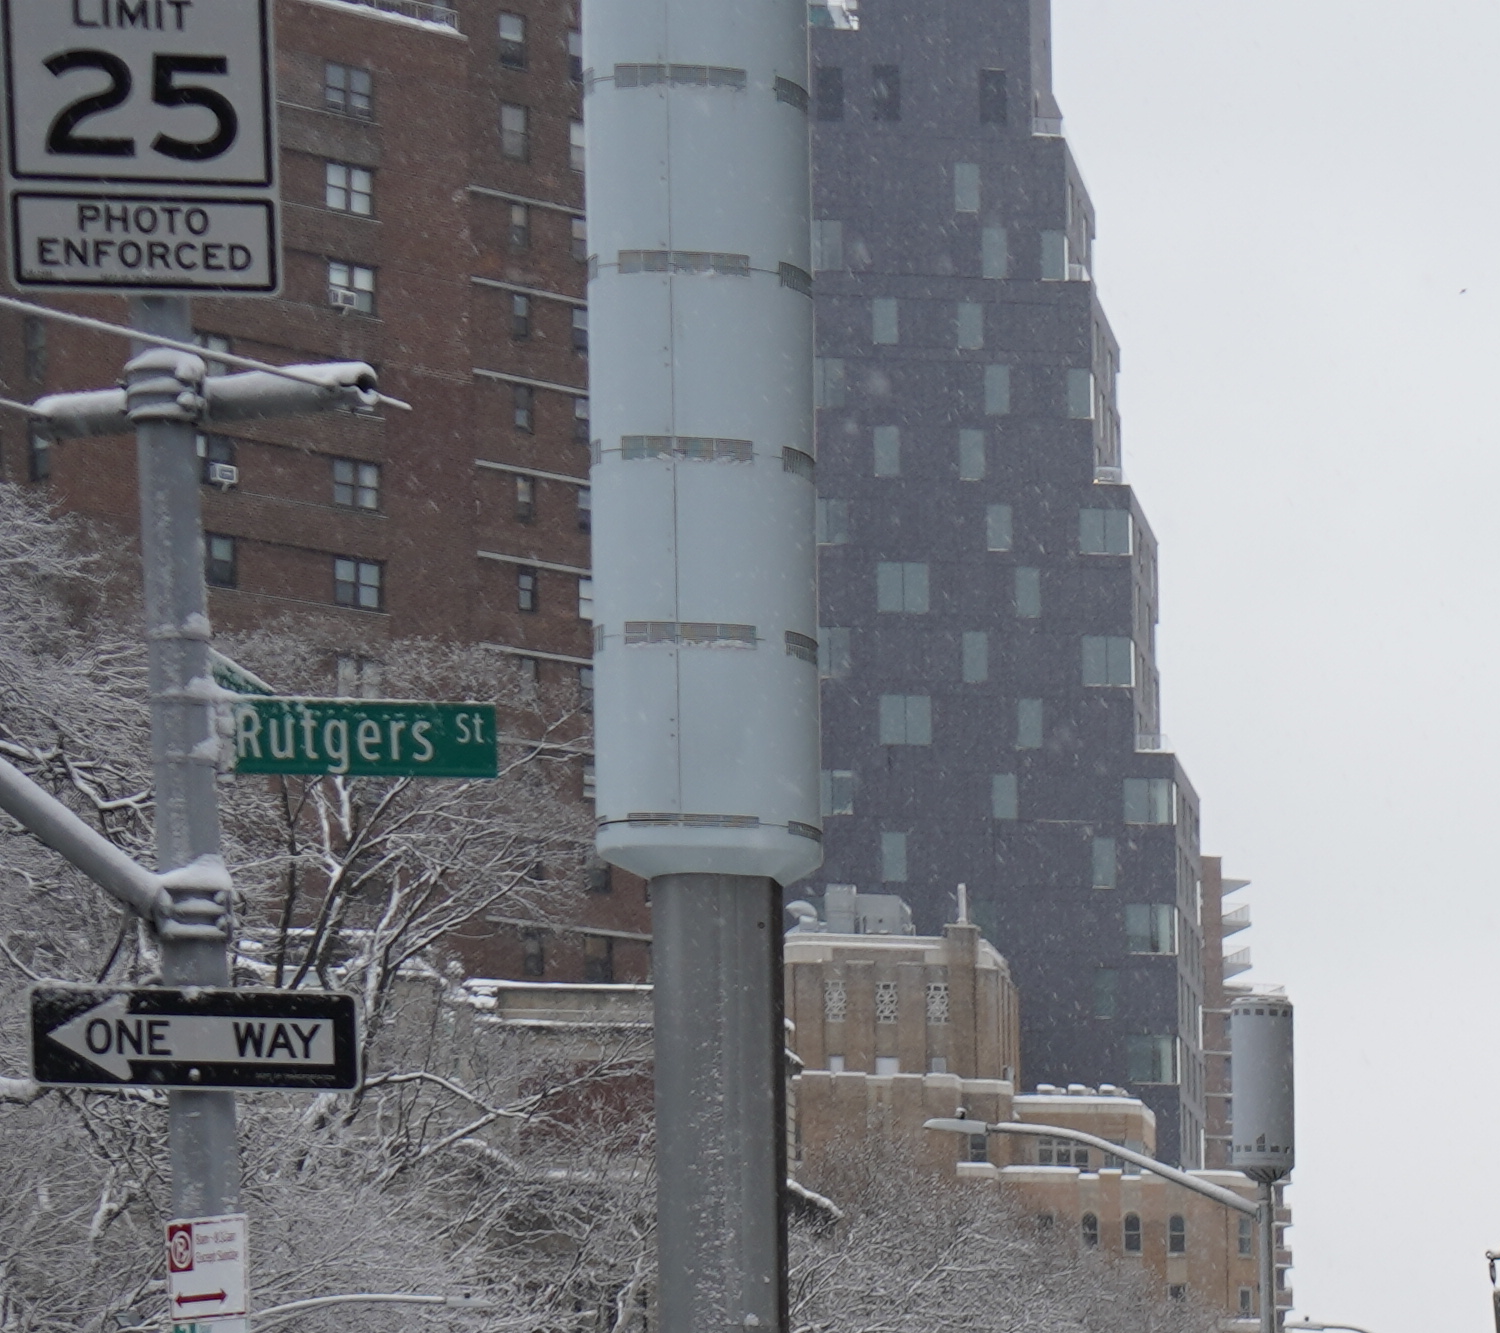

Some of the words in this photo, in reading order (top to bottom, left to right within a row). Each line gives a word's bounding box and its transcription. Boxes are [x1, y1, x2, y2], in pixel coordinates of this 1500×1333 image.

[73, 0, 193, 31] LIMIT
[43, 48, 238, 162] 25
[77, 204, 209, 235] PHOTO
[37, 237, 252, 271] ENFORCED
[238, 709, 436, 773] Rutgers
[455, 712, 486, 745] St
[85, 1018, 172, 1056] ONE
[233, 1023, 321, 1059] WAY
